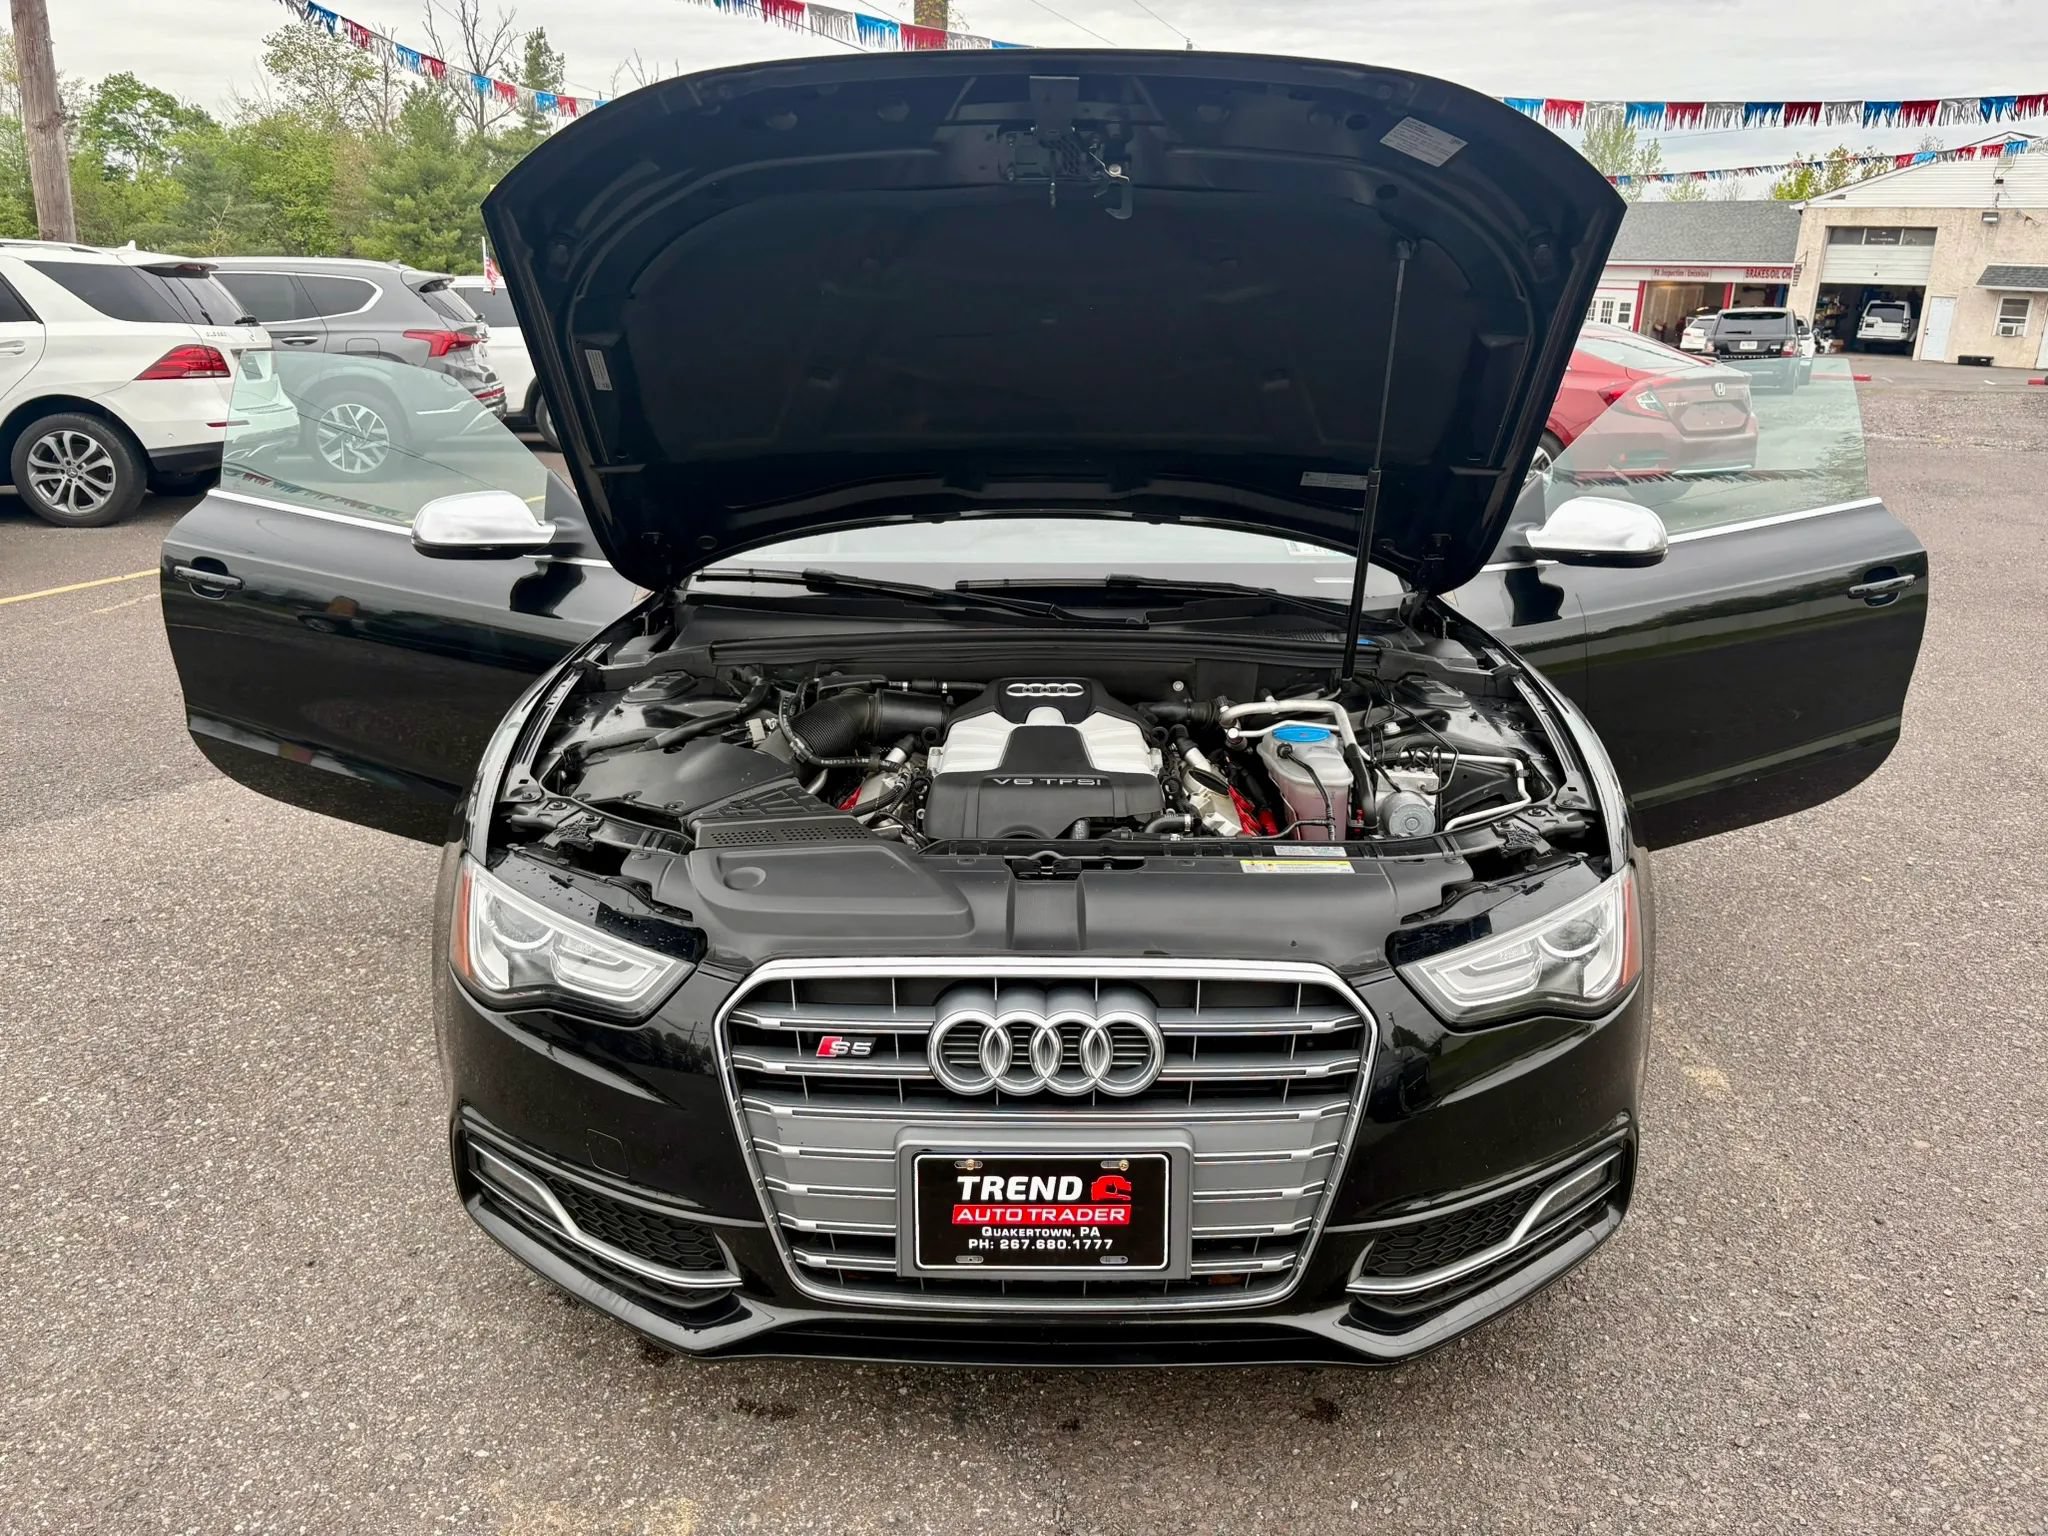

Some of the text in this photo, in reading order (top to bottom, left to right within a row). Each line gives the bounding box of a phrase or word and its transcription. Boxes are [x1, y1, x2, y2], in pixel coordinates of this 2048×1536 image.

[1745, 268, 1769, 279] BRAKES
[1039, 778, 1102, 786] TFSI
[828, 1040, 873, 1056] S5
[957, 1175, 1083, 1202] TREND
[955, 1207, 1126, 1222] AUTO TRADER
[1080, 1226, 1101, 1237] PA
[968, 1239, 1113, 1250] PH: 267.680.1777
